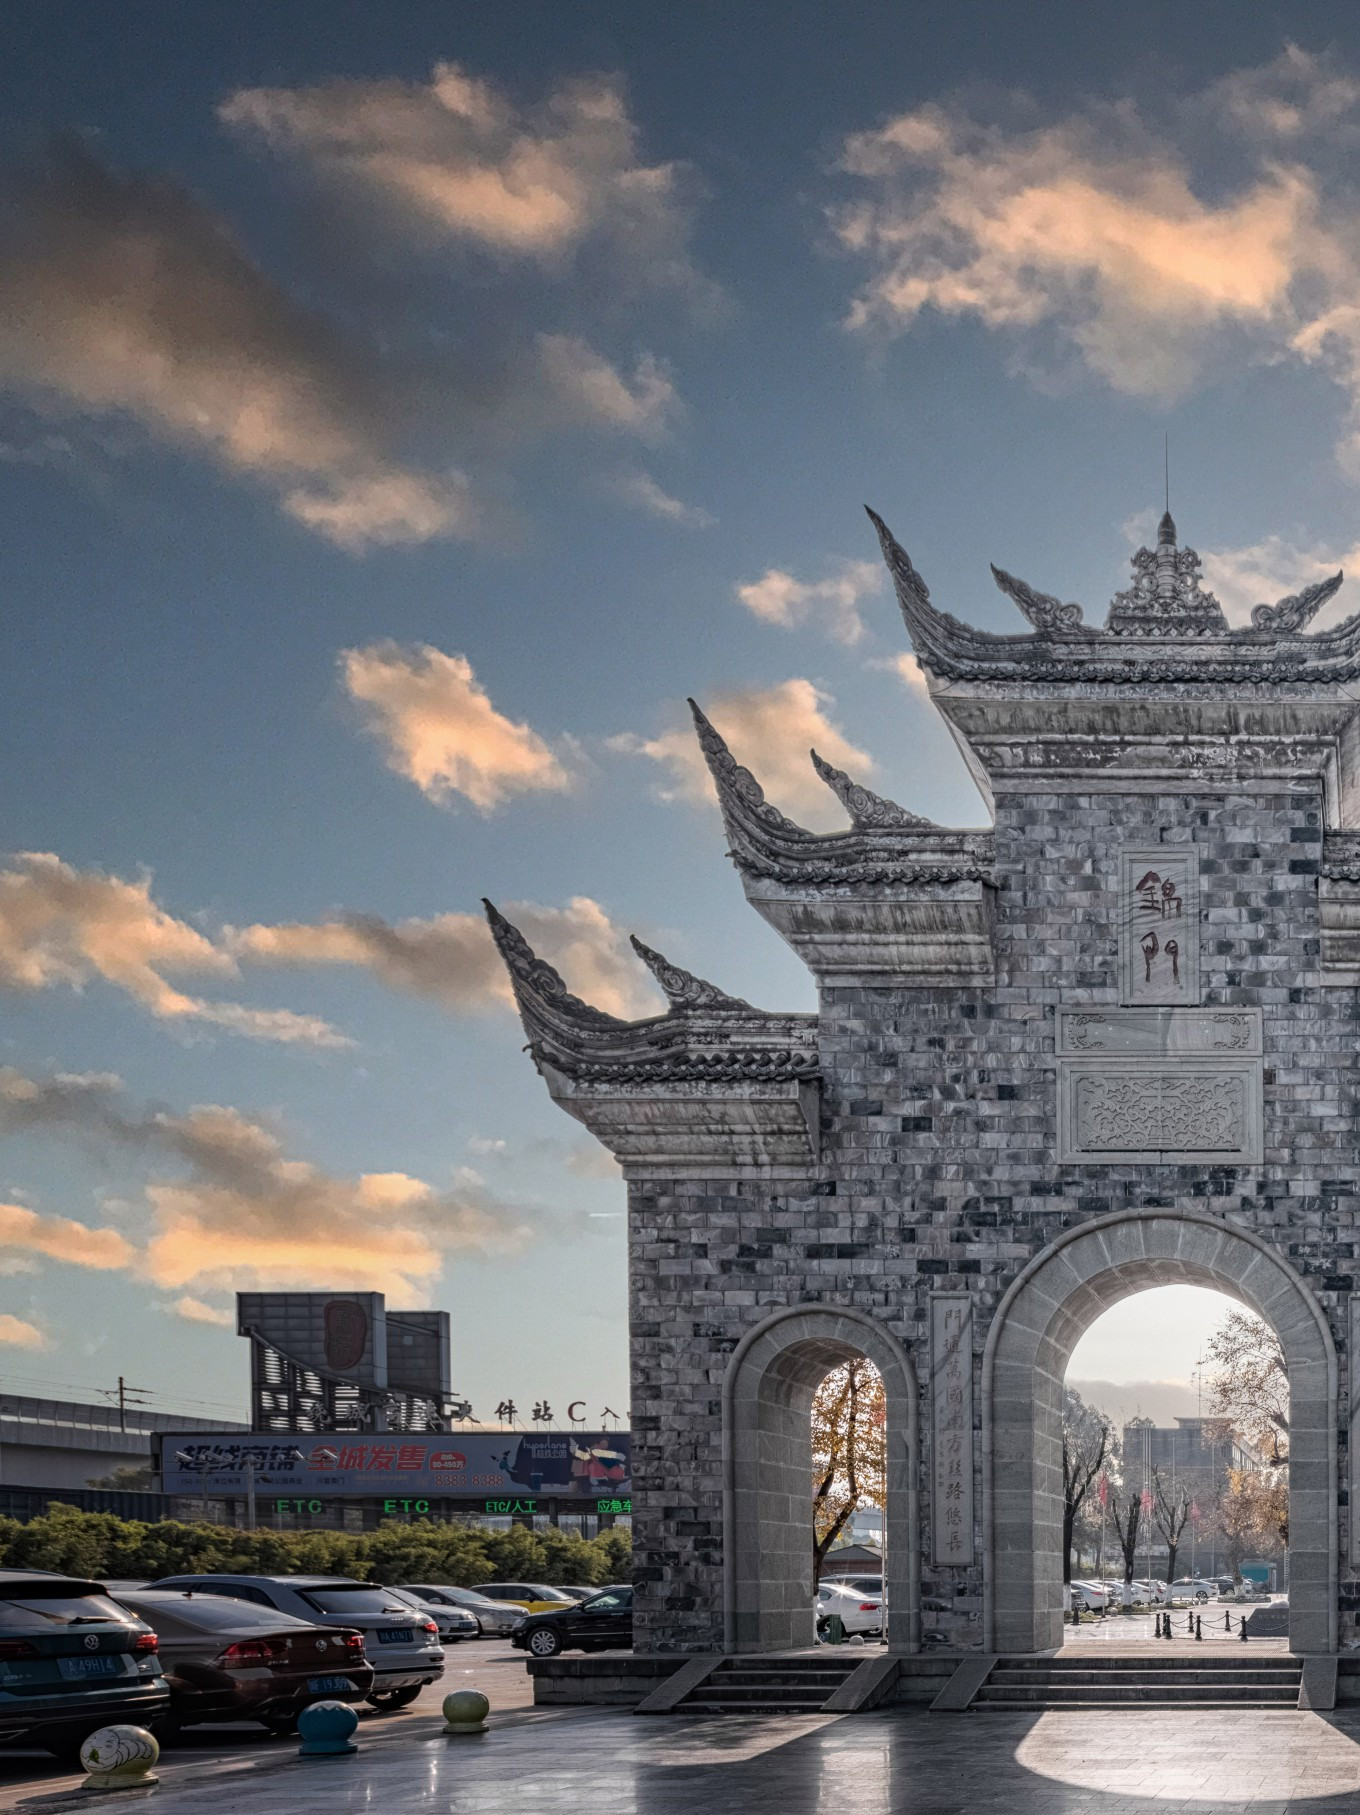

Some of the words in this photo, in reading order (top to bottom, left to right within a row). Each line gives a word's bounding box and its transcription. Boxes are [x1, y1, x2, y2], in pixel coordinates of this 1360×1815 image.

[307, 1444, 428, 1472] 全城发售
[435, 1474, 467, 1488] 8383
[471, 1474, 504, 1488] 8388
[277, 1500, 323, 1513] ETC
[384, 1500, 430, 1513] ETC
[485, 1501, 537, 1513] ETC/人工
